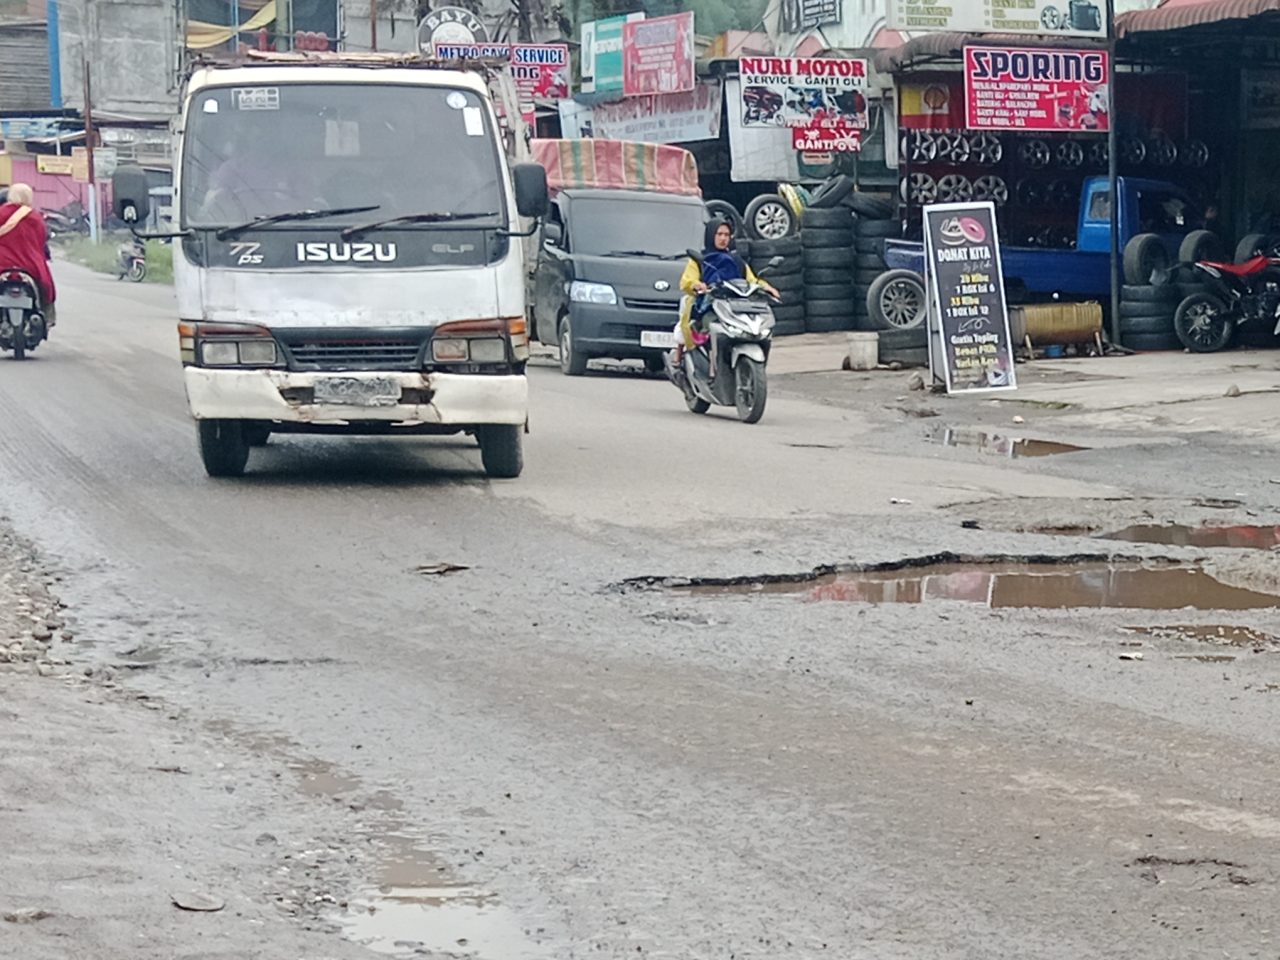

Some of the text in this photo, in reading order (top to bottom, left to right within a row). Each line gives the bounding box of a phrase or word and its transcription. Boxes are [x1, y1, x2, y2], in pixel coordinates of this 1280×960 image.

[426, 10, 481, 33] BAYU
[516, 48, 562, 63] SERVICE
[741, 58, 865, 77] NURI MOTOR
[971, 50, 1104, 82] SPORING
[747, 76, 861, 86] SERVICE GANTI OLI
[796, 139, 833, 150] GANTI
[297, 242, 396, 262] ISUZU
[937, 246, 991, 262] DONAT KITA
